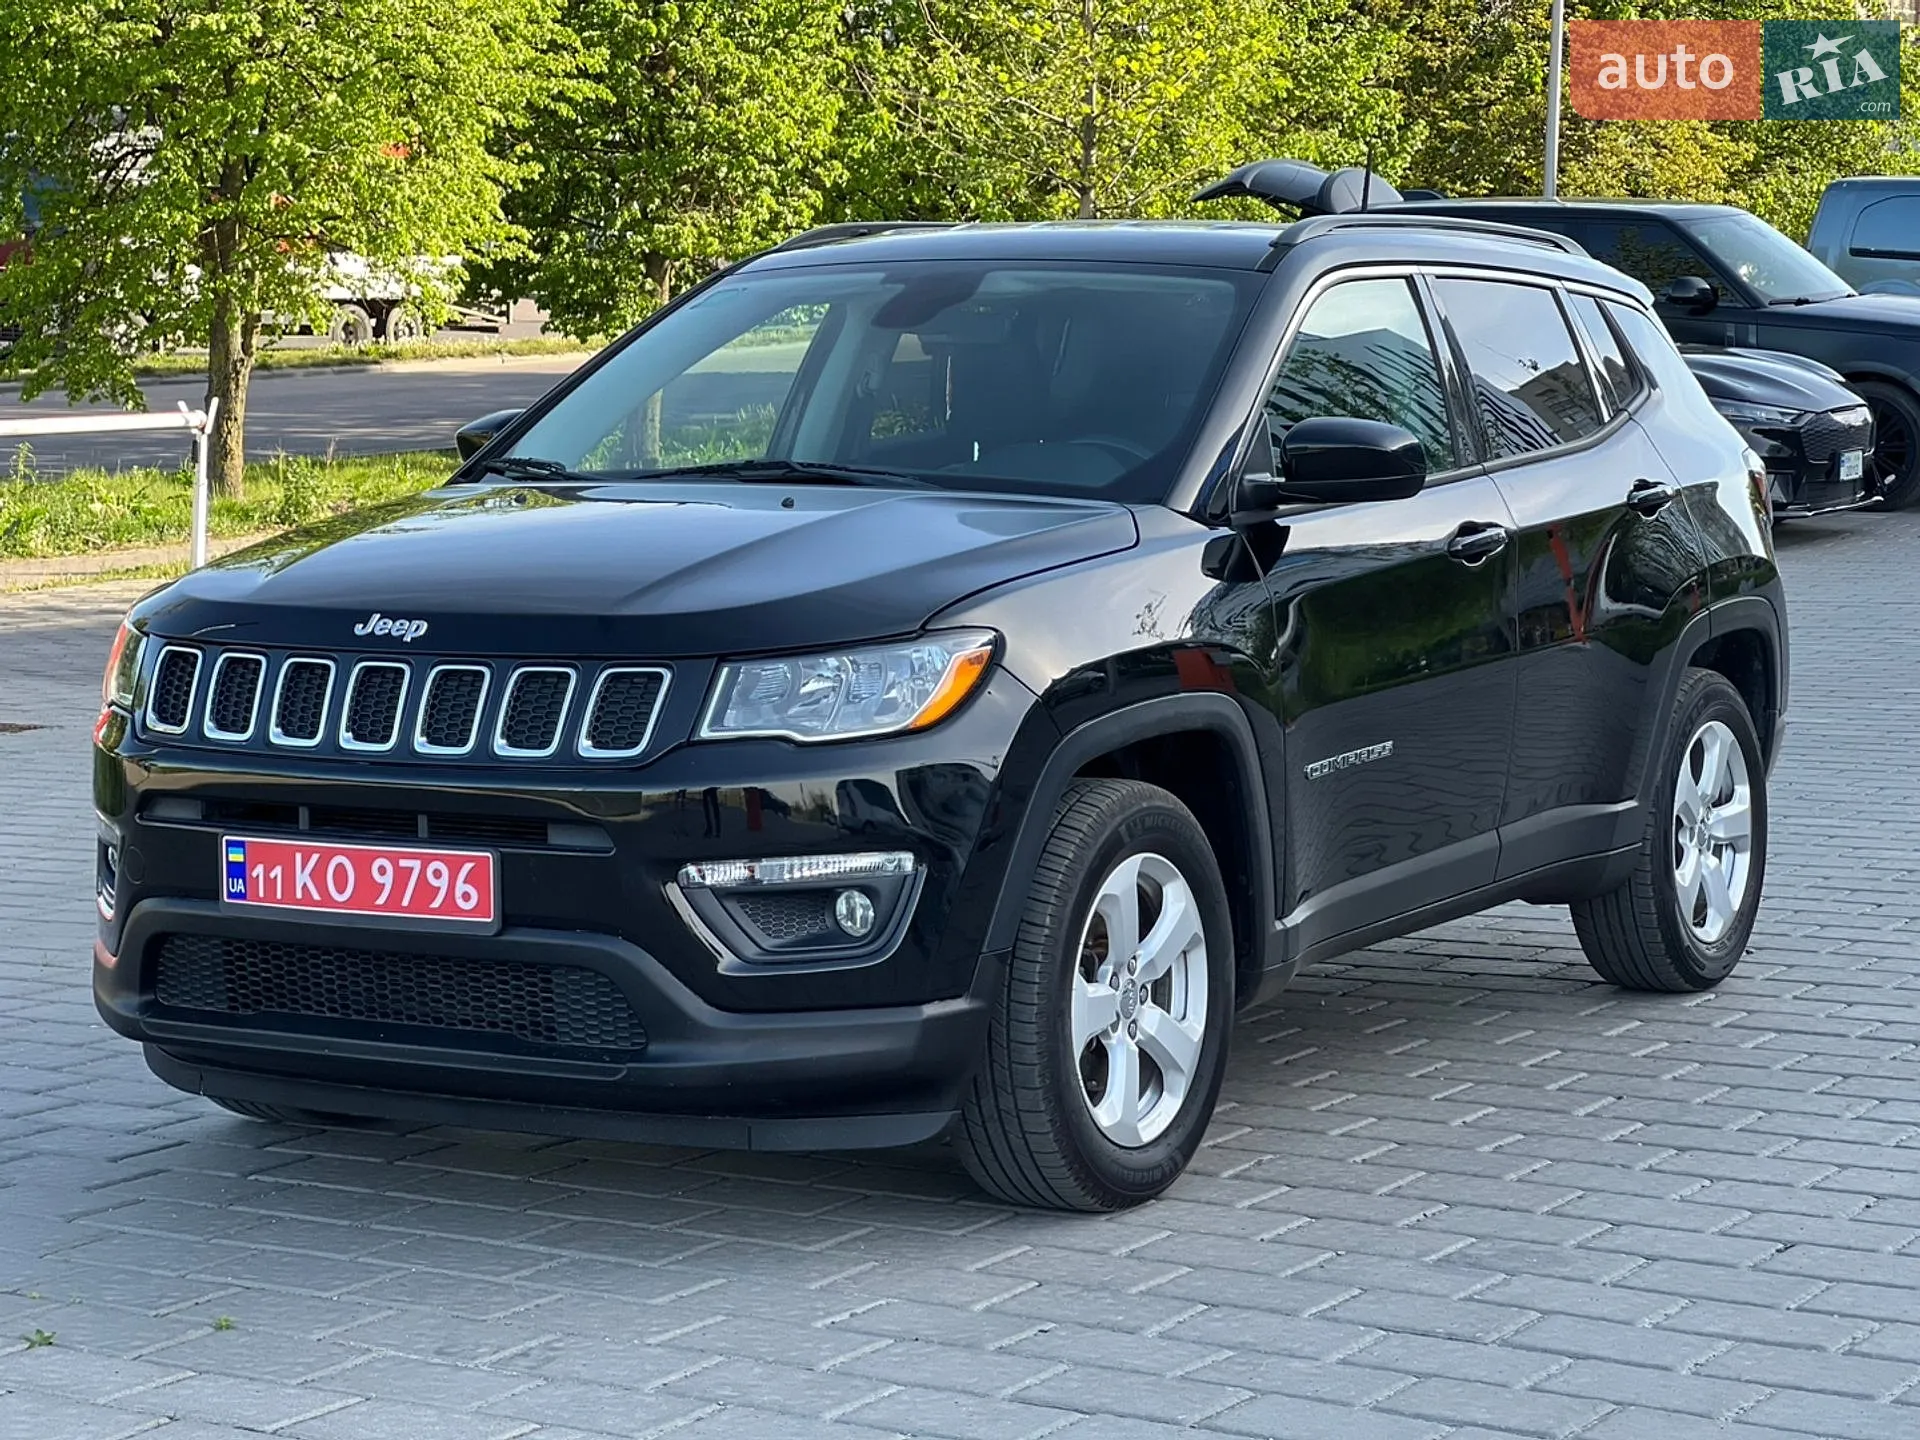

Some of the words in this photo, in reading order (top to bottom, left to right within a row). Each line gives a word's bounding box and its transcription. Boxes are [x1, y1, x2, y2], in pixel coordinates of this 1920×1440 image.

[354, 613, 428, 642] Jeep
[1304, 740, 1394, 780] COMPASS
[229, 878, 245, 894] UA
[251, 863, 283, 900] 11
[294, 852, 356, 903] KO
[370, 857, 479, 911] 9796
